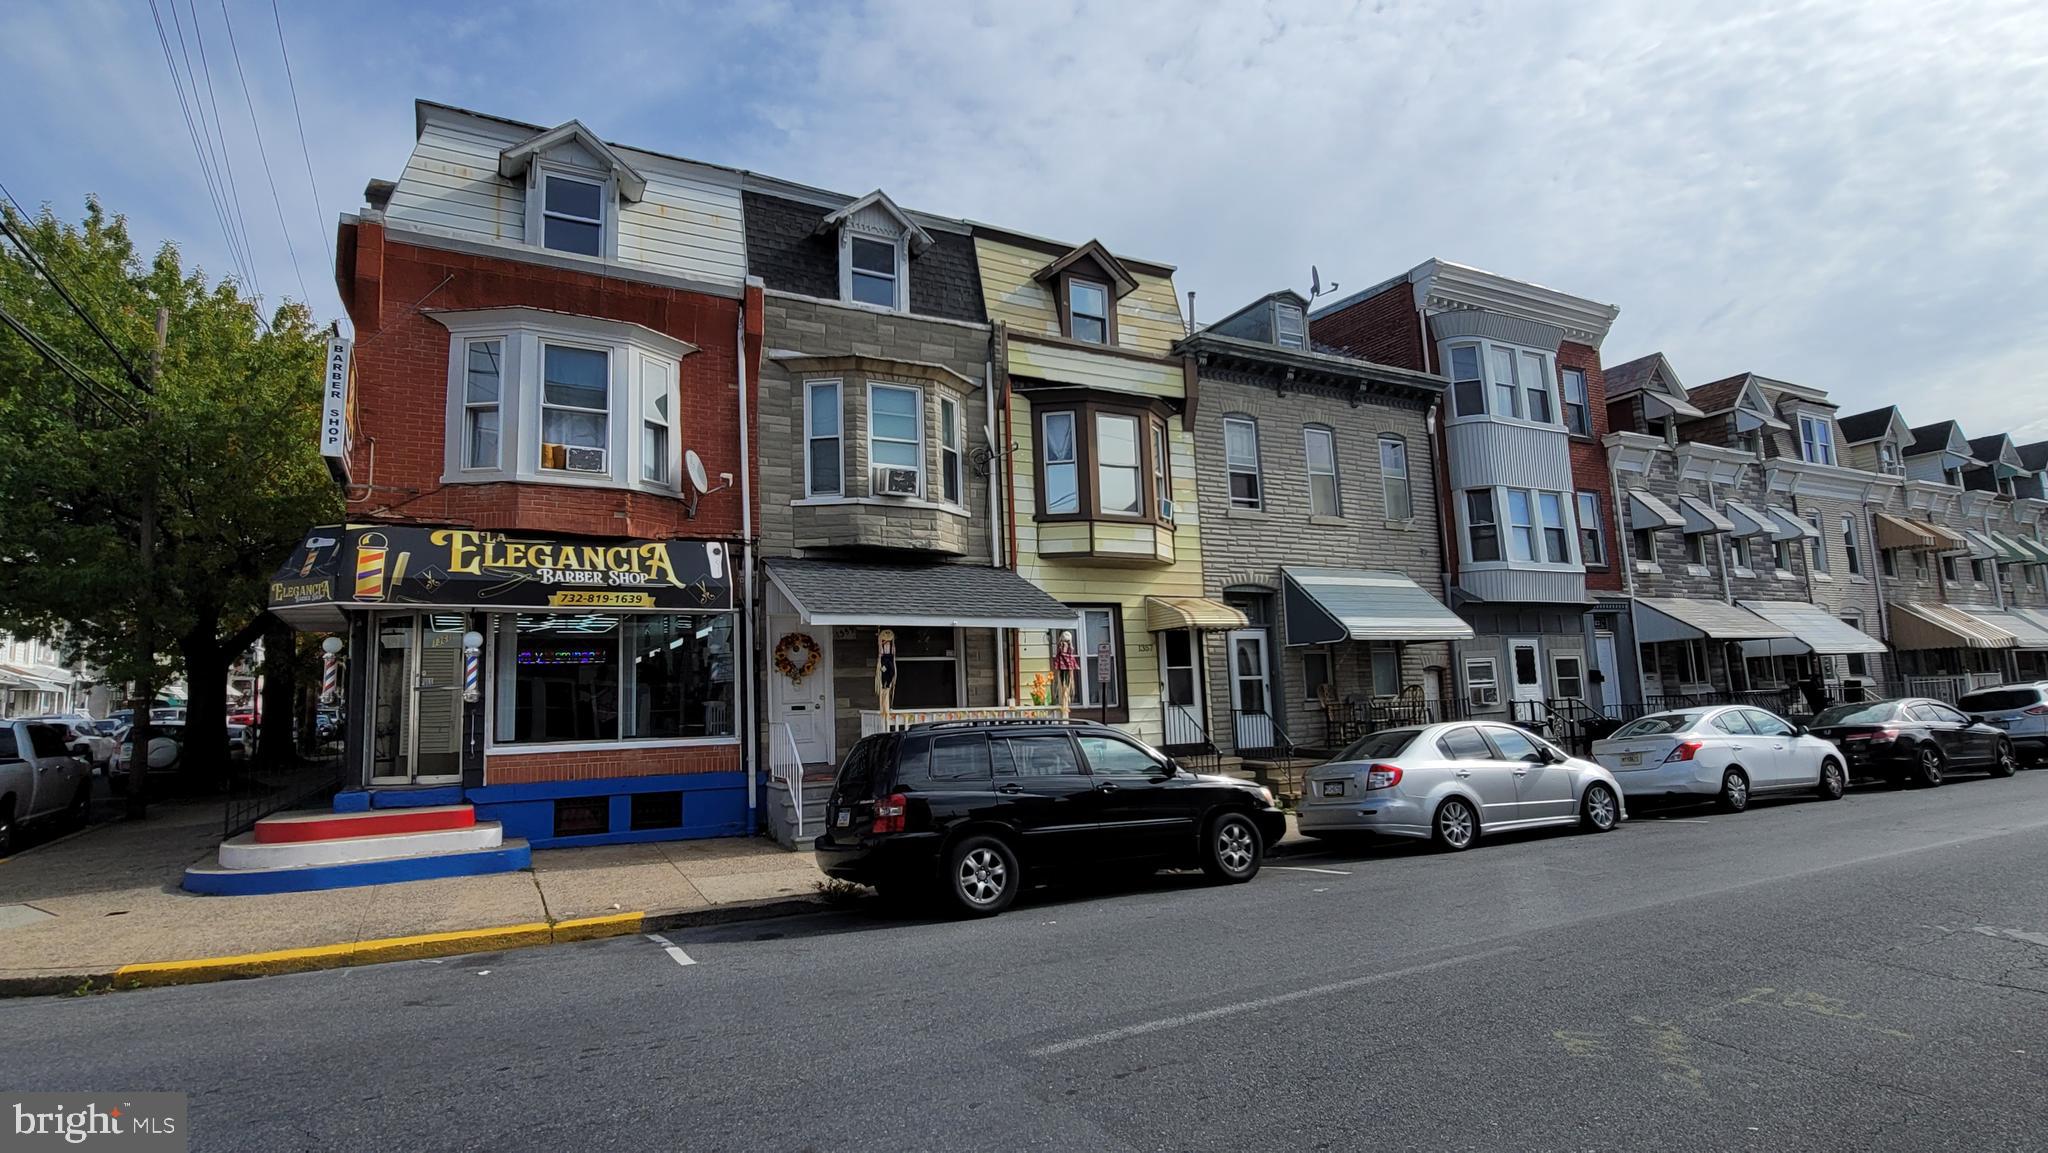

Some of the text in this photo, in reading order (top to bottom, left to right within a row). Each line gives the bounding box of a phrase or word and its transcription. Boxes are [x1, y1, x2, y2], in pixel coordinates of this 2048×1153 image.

[328, 345, 344, 445] BARBER SHOP
[481, 532, 506, 544] LA
[430, 529, 686, 589] ELEGANCIA
[536, 568, 649, 587] BARBER SHOP
[560, 593, 643, 604] 732-819-1639
